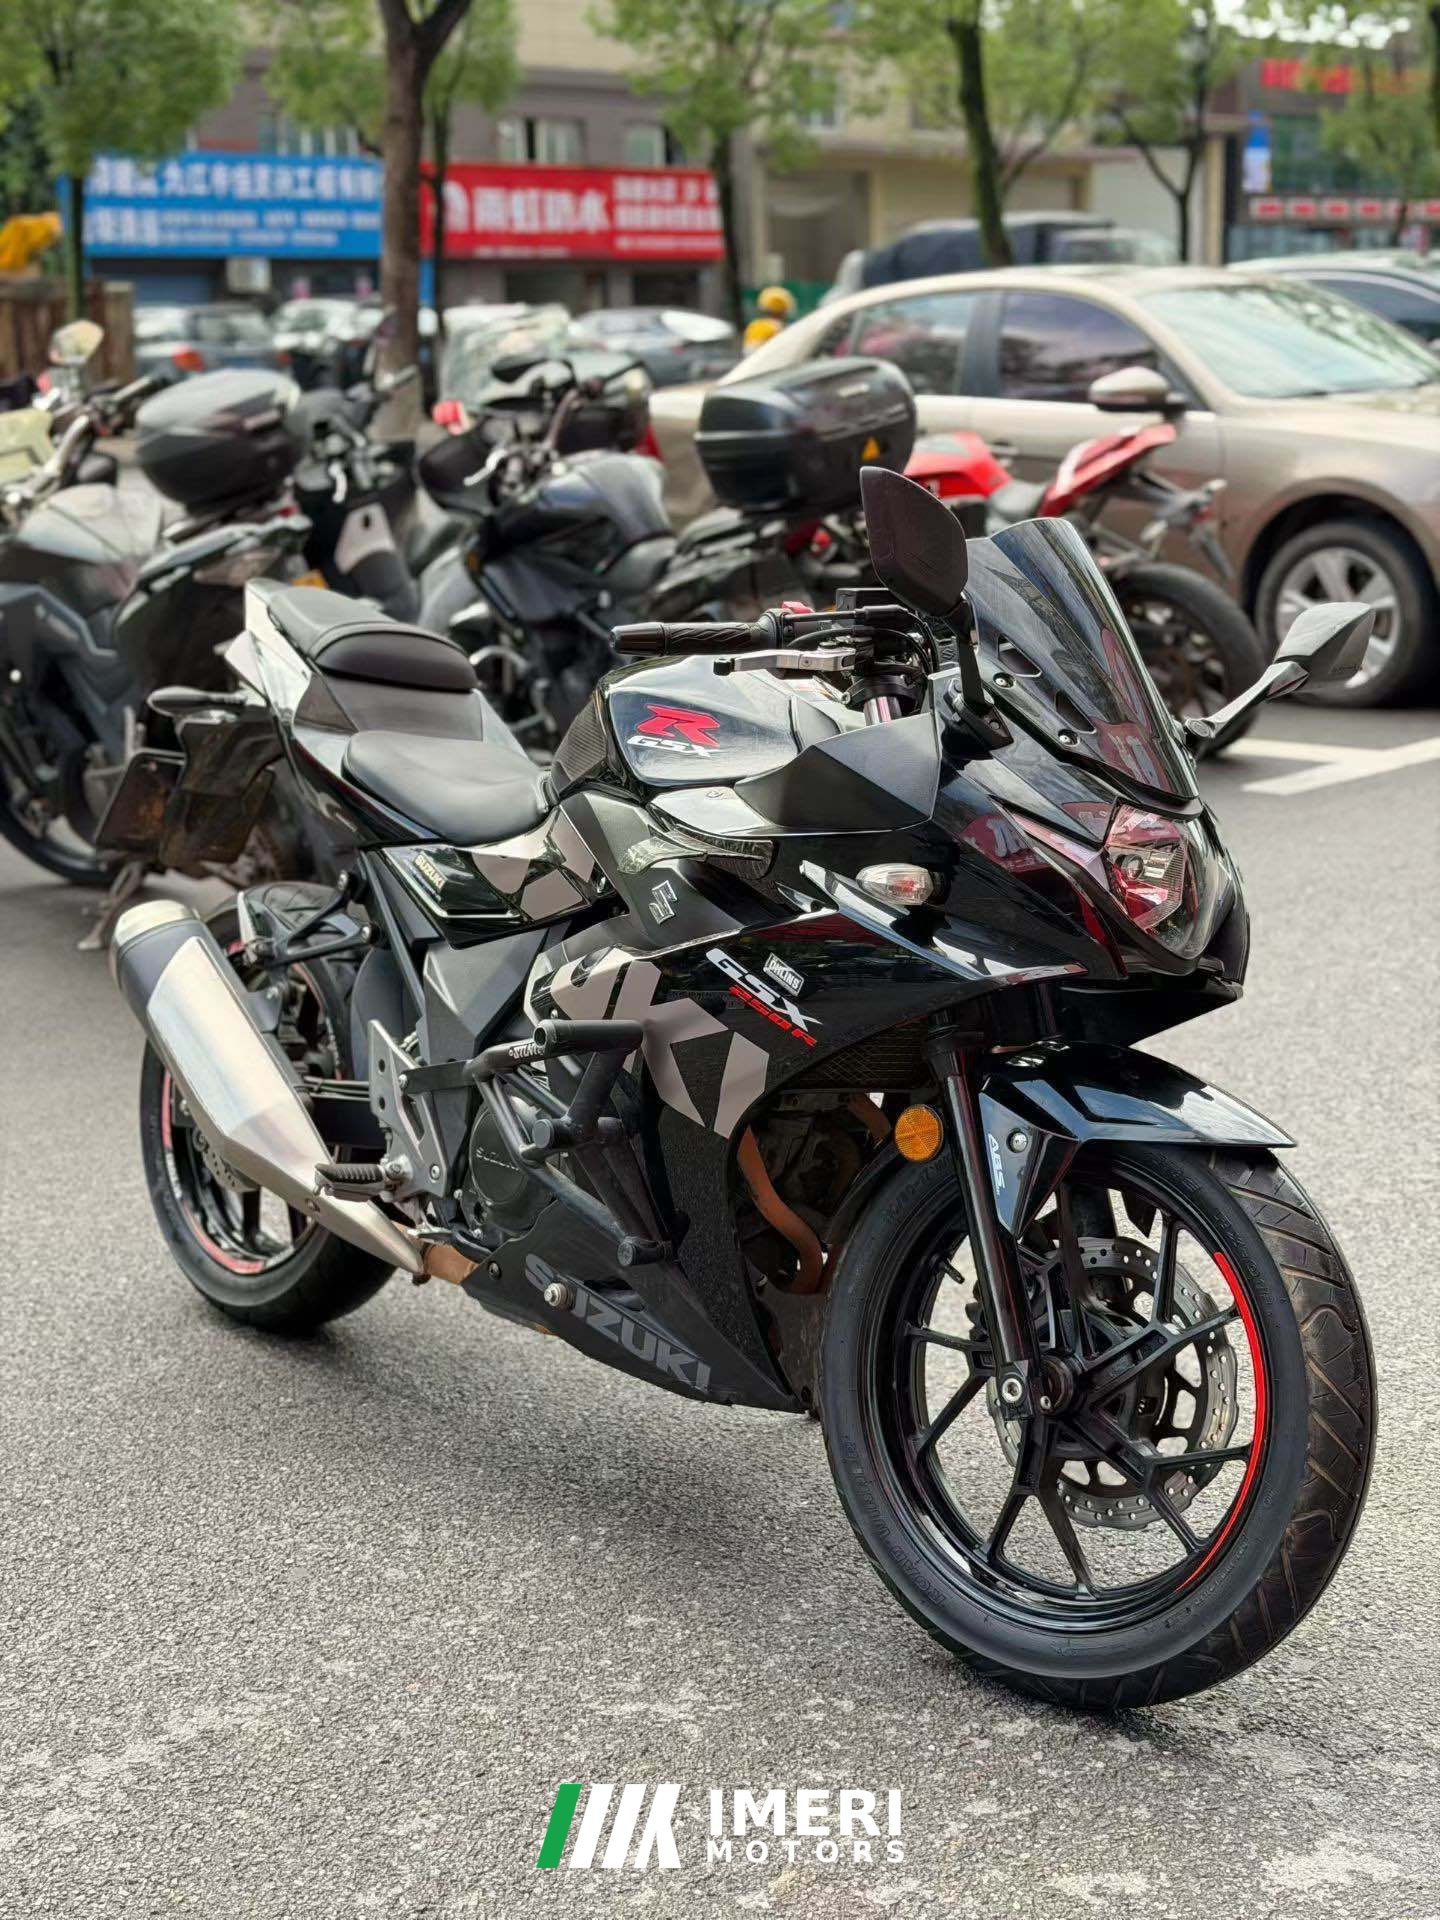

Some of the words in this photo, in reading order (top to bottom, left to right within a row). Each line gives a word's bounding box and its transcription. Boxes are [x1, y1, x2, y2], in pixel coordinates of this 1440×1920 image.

[626, 734, 718, 758] GSX
[414, 853, 447, 889] SUZUKI
[705, 947, 824, 1033] GSX
[987, 1133, 1006, 1196] ABS
